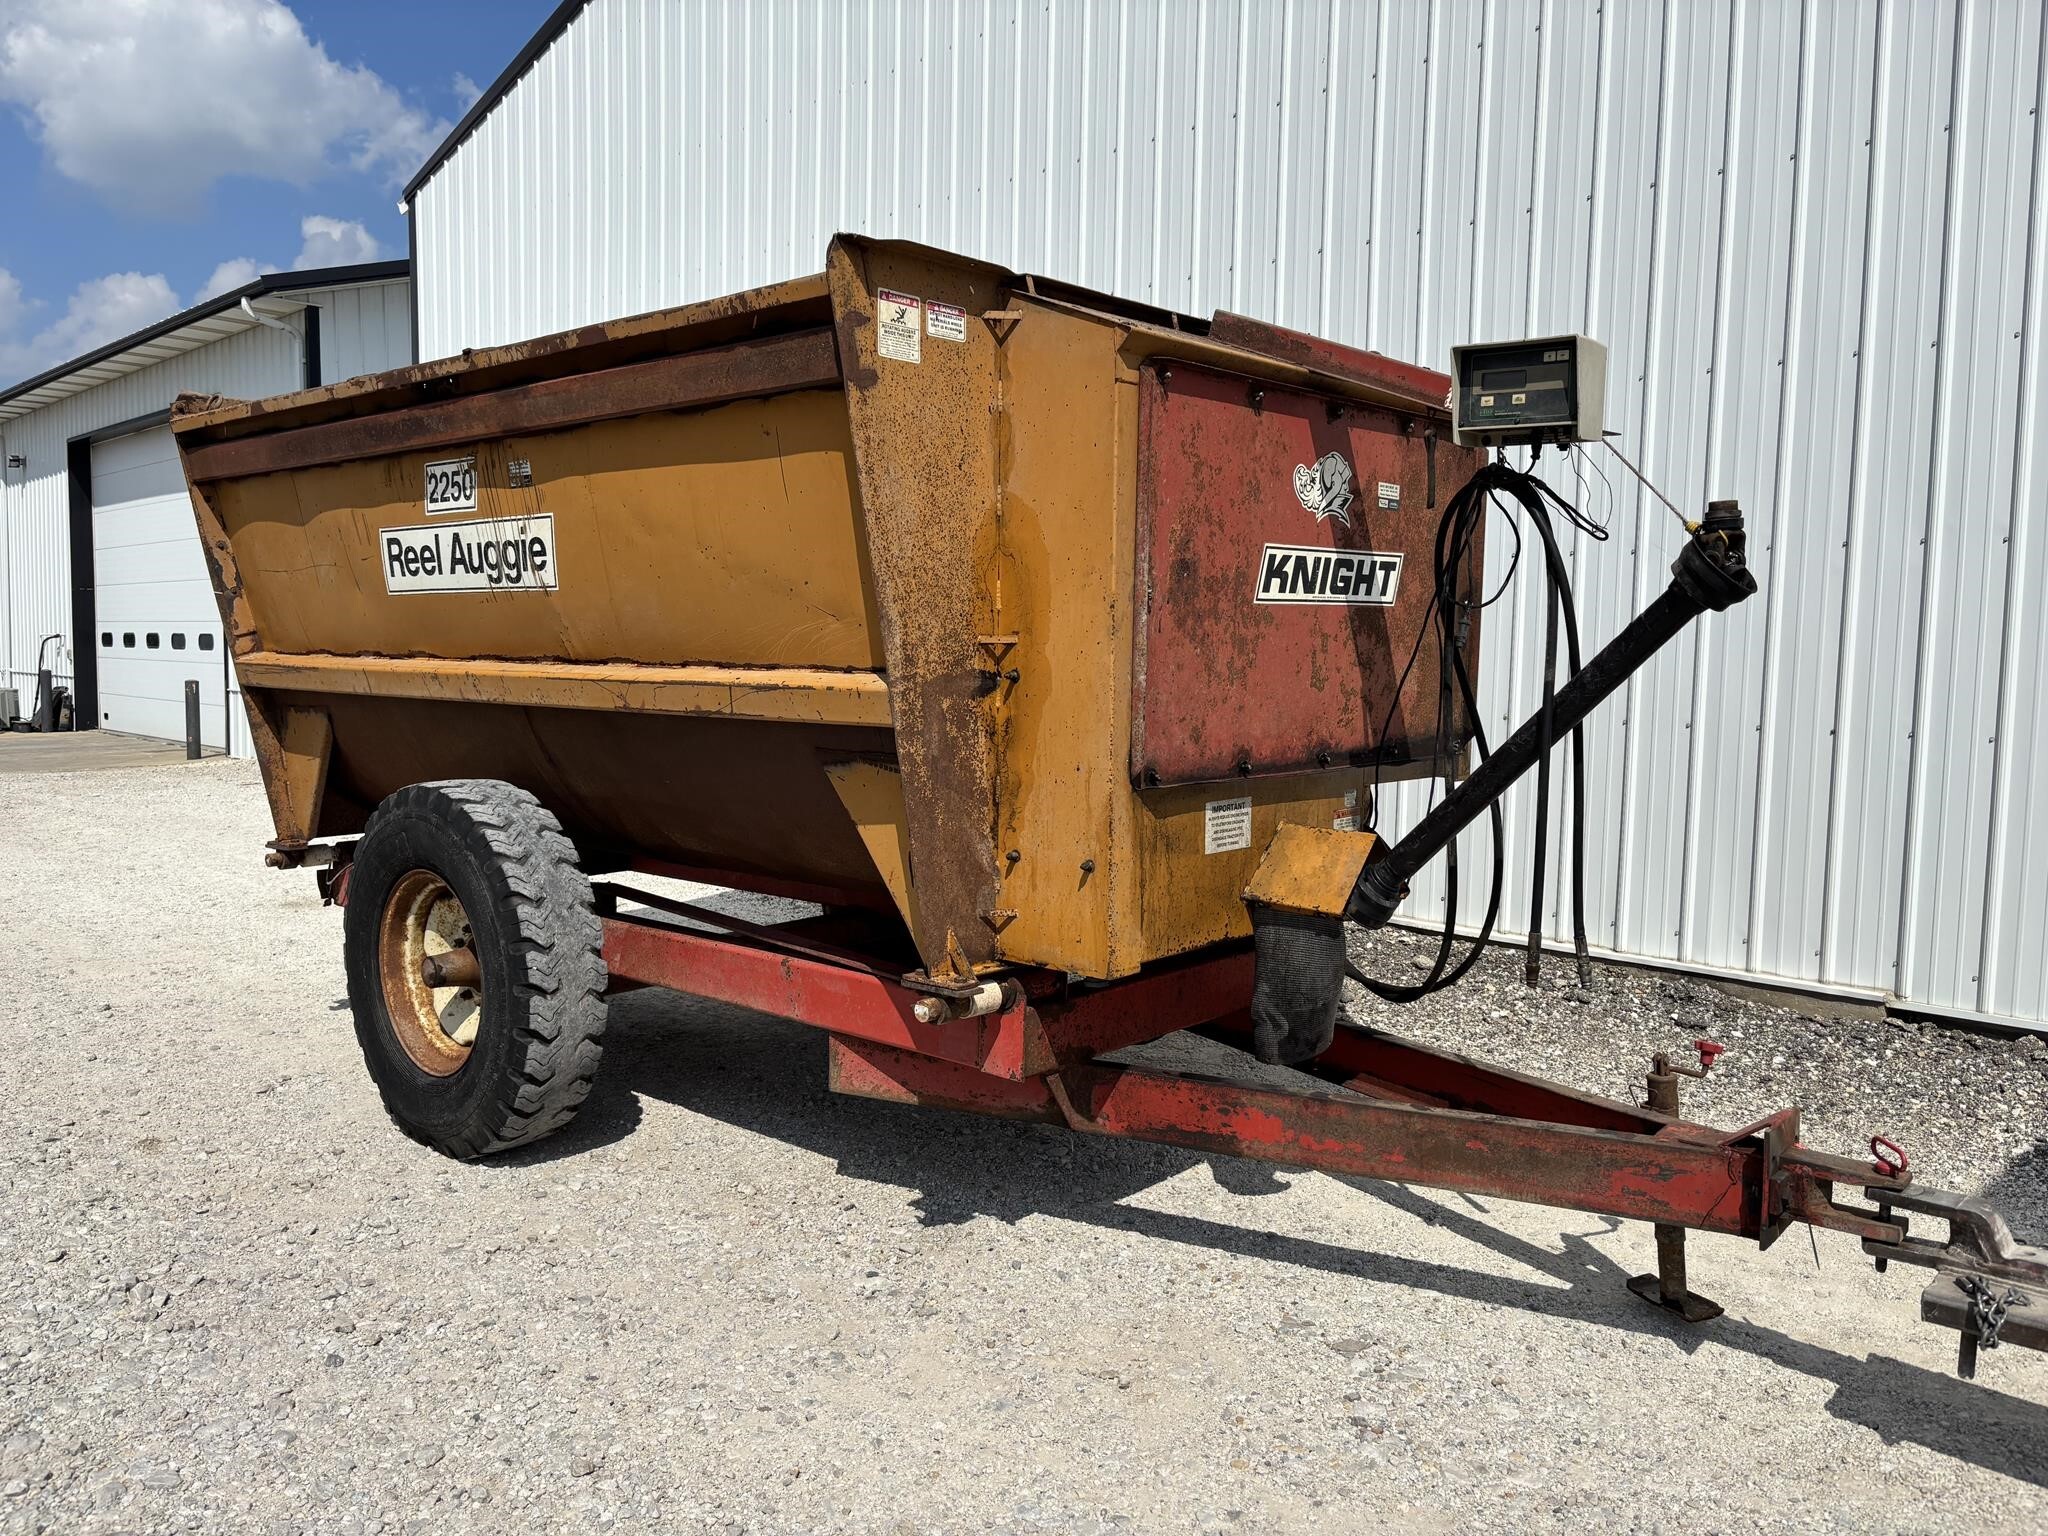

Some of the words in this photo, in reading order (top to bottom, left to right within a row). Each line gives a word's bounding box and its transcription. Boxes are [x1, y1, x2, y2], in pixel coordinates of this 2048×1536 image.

[888, 294, 911, 305] DANGER
[939, 304, 960, 315] DANGER
[930, 317, 950, 325] MAERIALS
[881, 323, 901, 333] ROTATING
[428, 467, 474, 504] 2250
[386, 533, 444, 578] Reel
[450, 526, 548, 585] Auggie
[1261, 553, 1398, 597] KNIGHT
[1212, 802, 1245, 813] IMPORTANT
